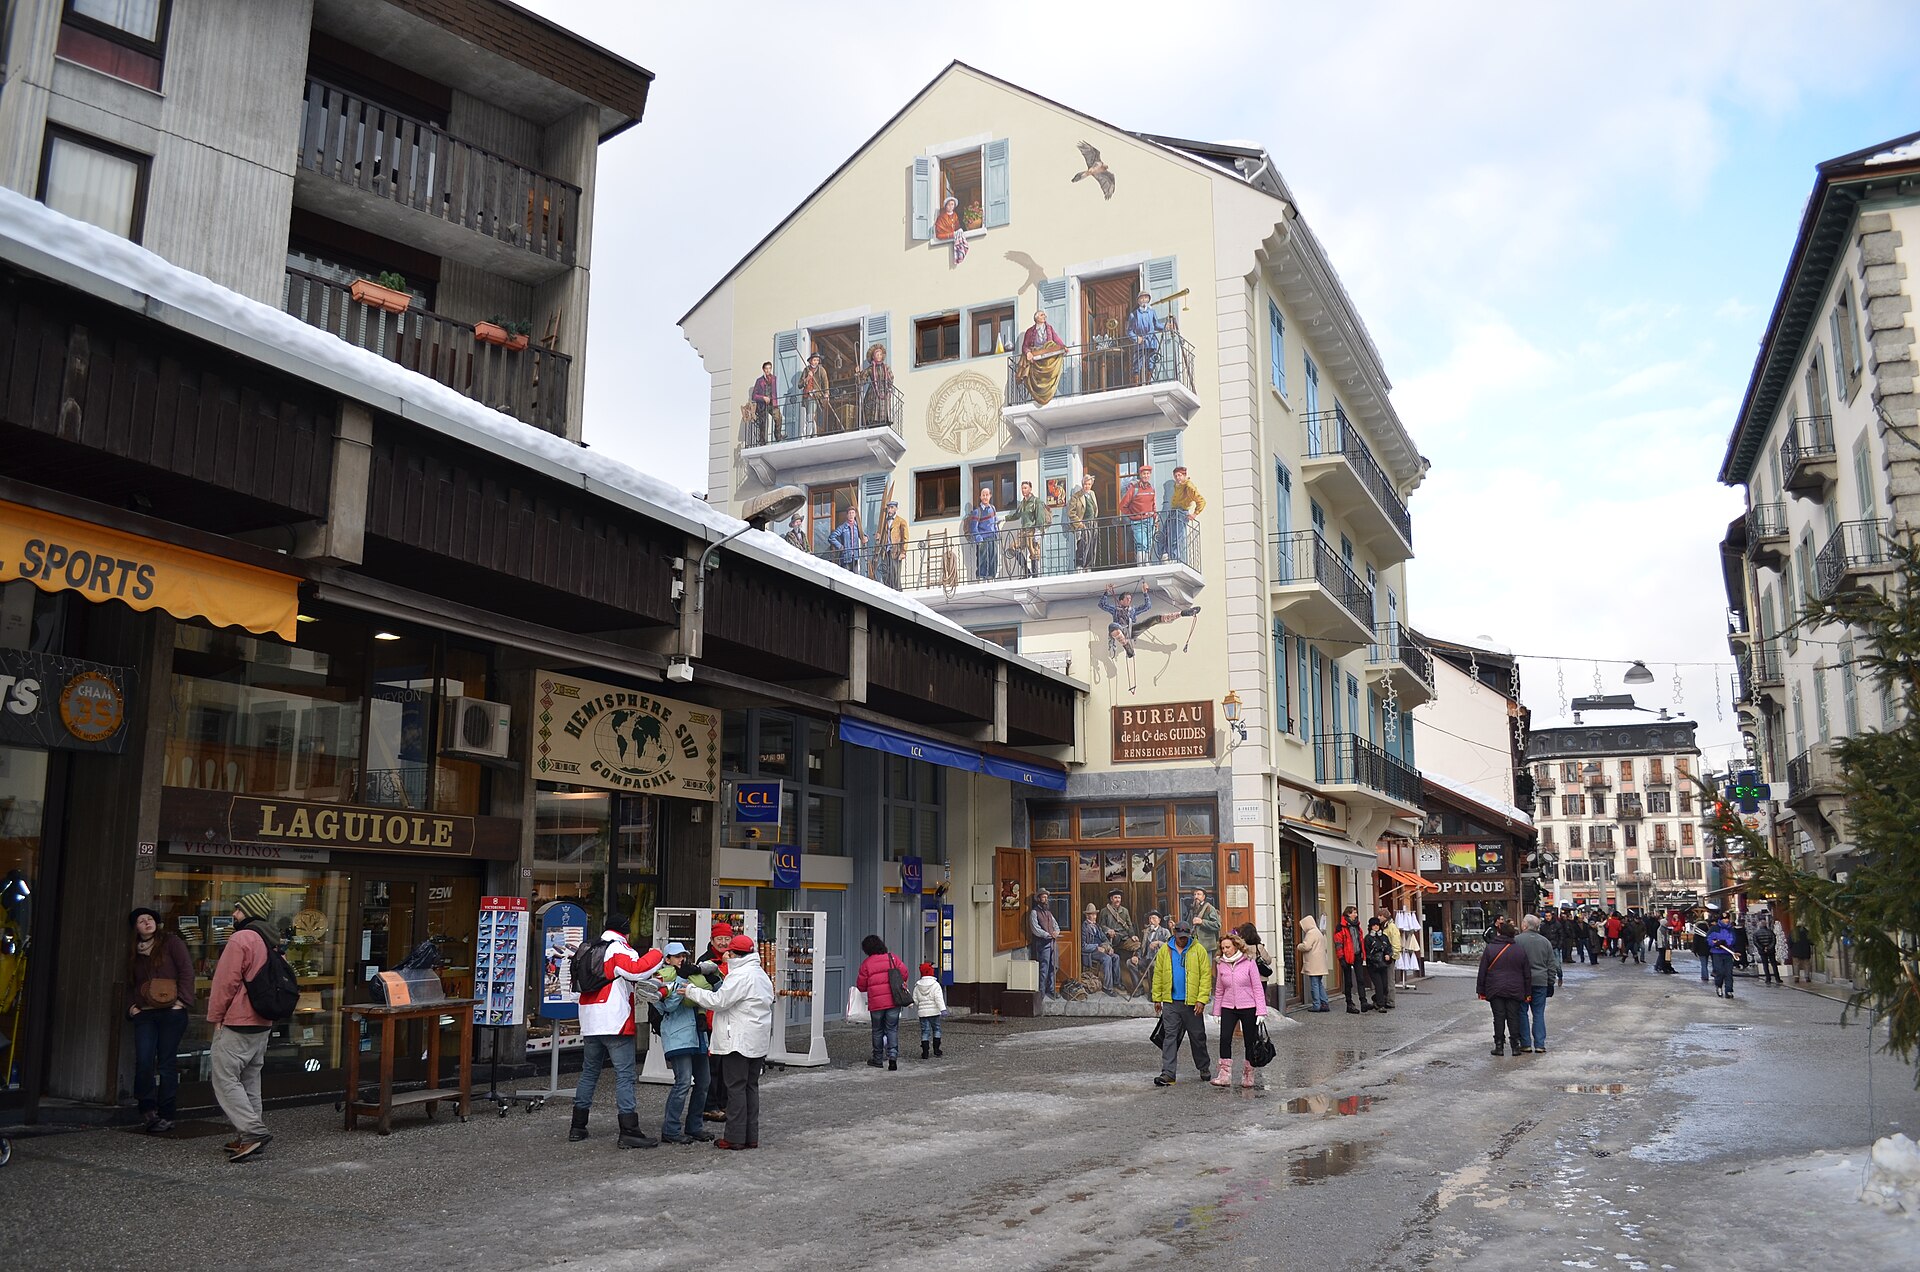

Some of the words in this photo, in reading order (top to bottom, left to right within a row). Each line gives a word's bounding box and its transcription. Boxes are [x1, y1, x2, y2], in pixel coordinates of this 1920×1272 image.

[936, 385, 957, 412] GUIDES
[958, 381, 994, 410] CHAMONIX
[19, 539, 155, 600] SPORTS
[78, 685, 111, 700] CHAM
[1122, 706, 1202, 726] BUREAU
[564, 693, 673, 740] HEMISPHERE
[675, 724, 699, 759] SUD
[1121, 731, 1131, 743] de
[1132, 731, 1140, 743] la
[1153, 729, 1168, 742] des
[1169, 726, 1206, 741] GUIDES
[911, 746, 923, 757] LCL
[1124, 745, 1204, 758] RENSEIGNEMENTS
[590, 759, 676, 789] COMPAGNIE
[1023, 773, 1034, 783] LCL
[738, 791, 774, 805] LCL
[258, 804, 454, 847] LAGUIOLE
[141, 844, 154, 854] 92
[184, 842, 281, 858] VICTORINOX
[776, 853, 797, 868] LCL
[903, 864, 920, 877] LCL
